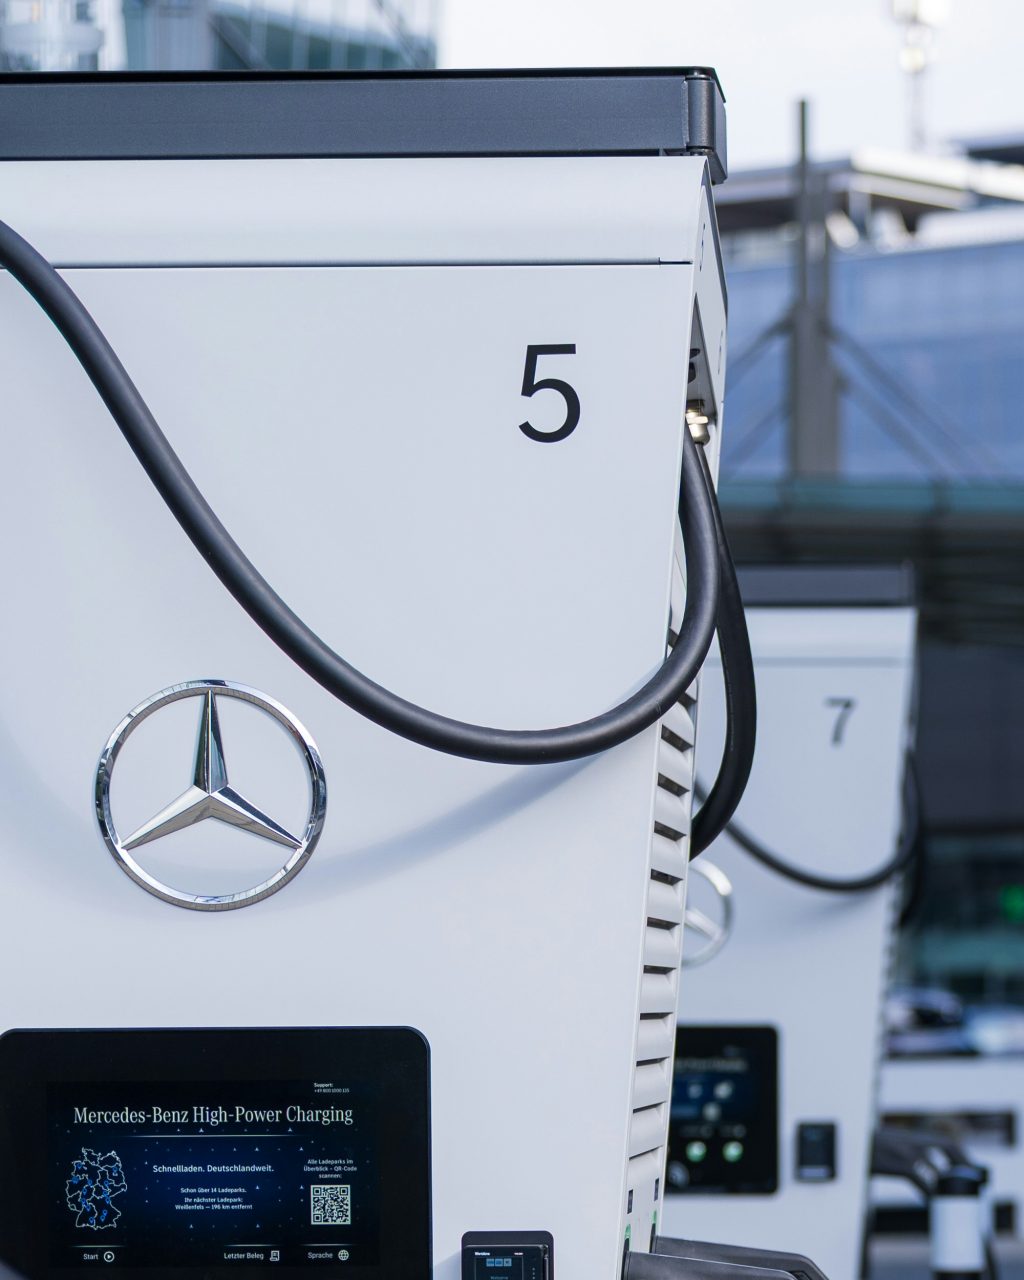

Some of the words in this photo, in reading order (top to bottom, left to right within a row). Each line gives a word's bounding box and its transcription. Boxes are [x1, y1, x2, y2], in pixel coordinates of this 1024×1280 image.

[518, 343, 581, 443] 5
[822, 697, 857, 747] 7
[74, 1106, 189, 1123] Mercedes-Benz
[193, 1106, 282, 1126] High-Power
[286, 1105, 353, 1125] Charging
[207, 1164, 274, 1172] Deutschlandweit.
[218, 1186, 247, 1194] Ladeparks.
[246, 1252, 264, 1261] Beleg
[308, 1251, 333, 1260] Sprache
